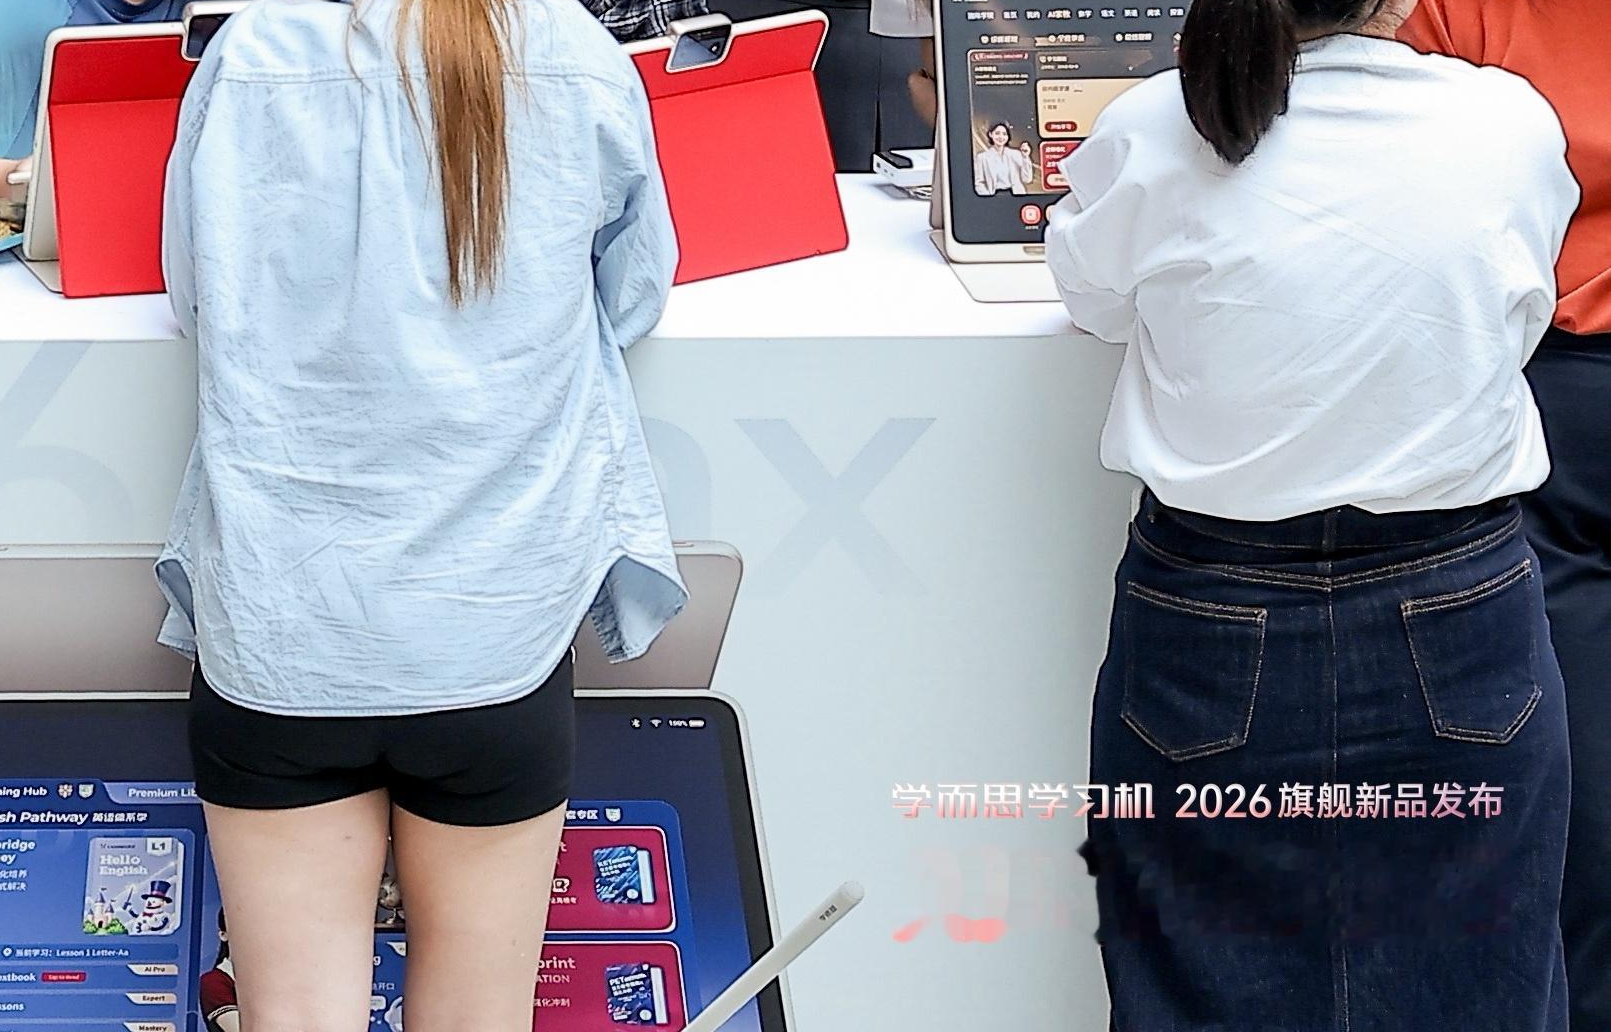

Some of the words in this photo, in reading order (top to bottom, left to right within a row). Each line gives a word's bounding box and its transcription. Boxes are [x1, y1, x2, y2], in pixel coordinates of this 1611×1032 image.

[23, 787, 48, 797] Hub
[128, 788, 178, 798] Premium
[20, 811, 89, 825] Pathway
[151, 841, 166, 851] L1
[100, 854, 141, 865] Hello
[99, 866, 148, 877] English
[56, 948, 85, 957] Lesson
[142, 994, 165, 1002] Expert
